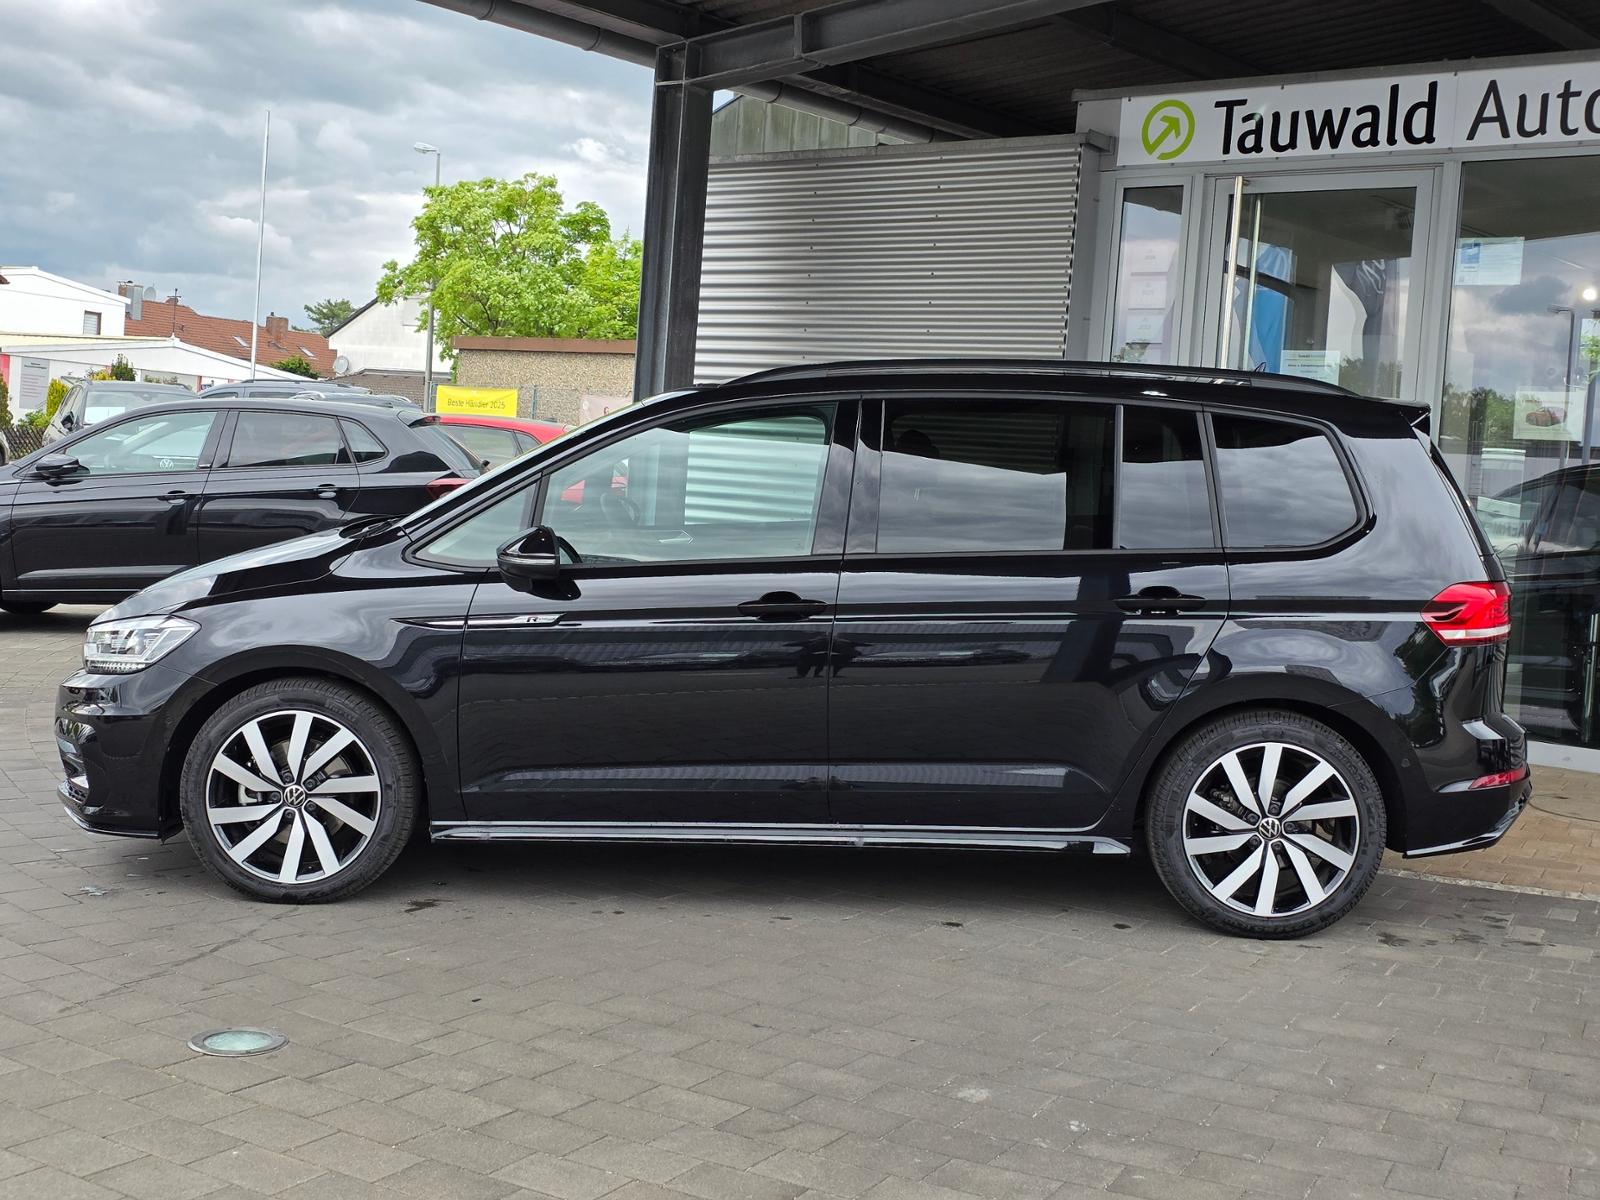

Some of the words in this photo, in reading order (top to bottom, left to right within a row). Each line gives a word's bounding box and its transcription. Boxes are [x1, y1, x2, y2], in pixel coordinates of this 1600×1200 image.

[1214, 80, 1438, 155] Tauwald
[447, 398, 464, 407] Beste
[465, 399, 489, 408] Händler
[490, 400, 506, 410] 2025
